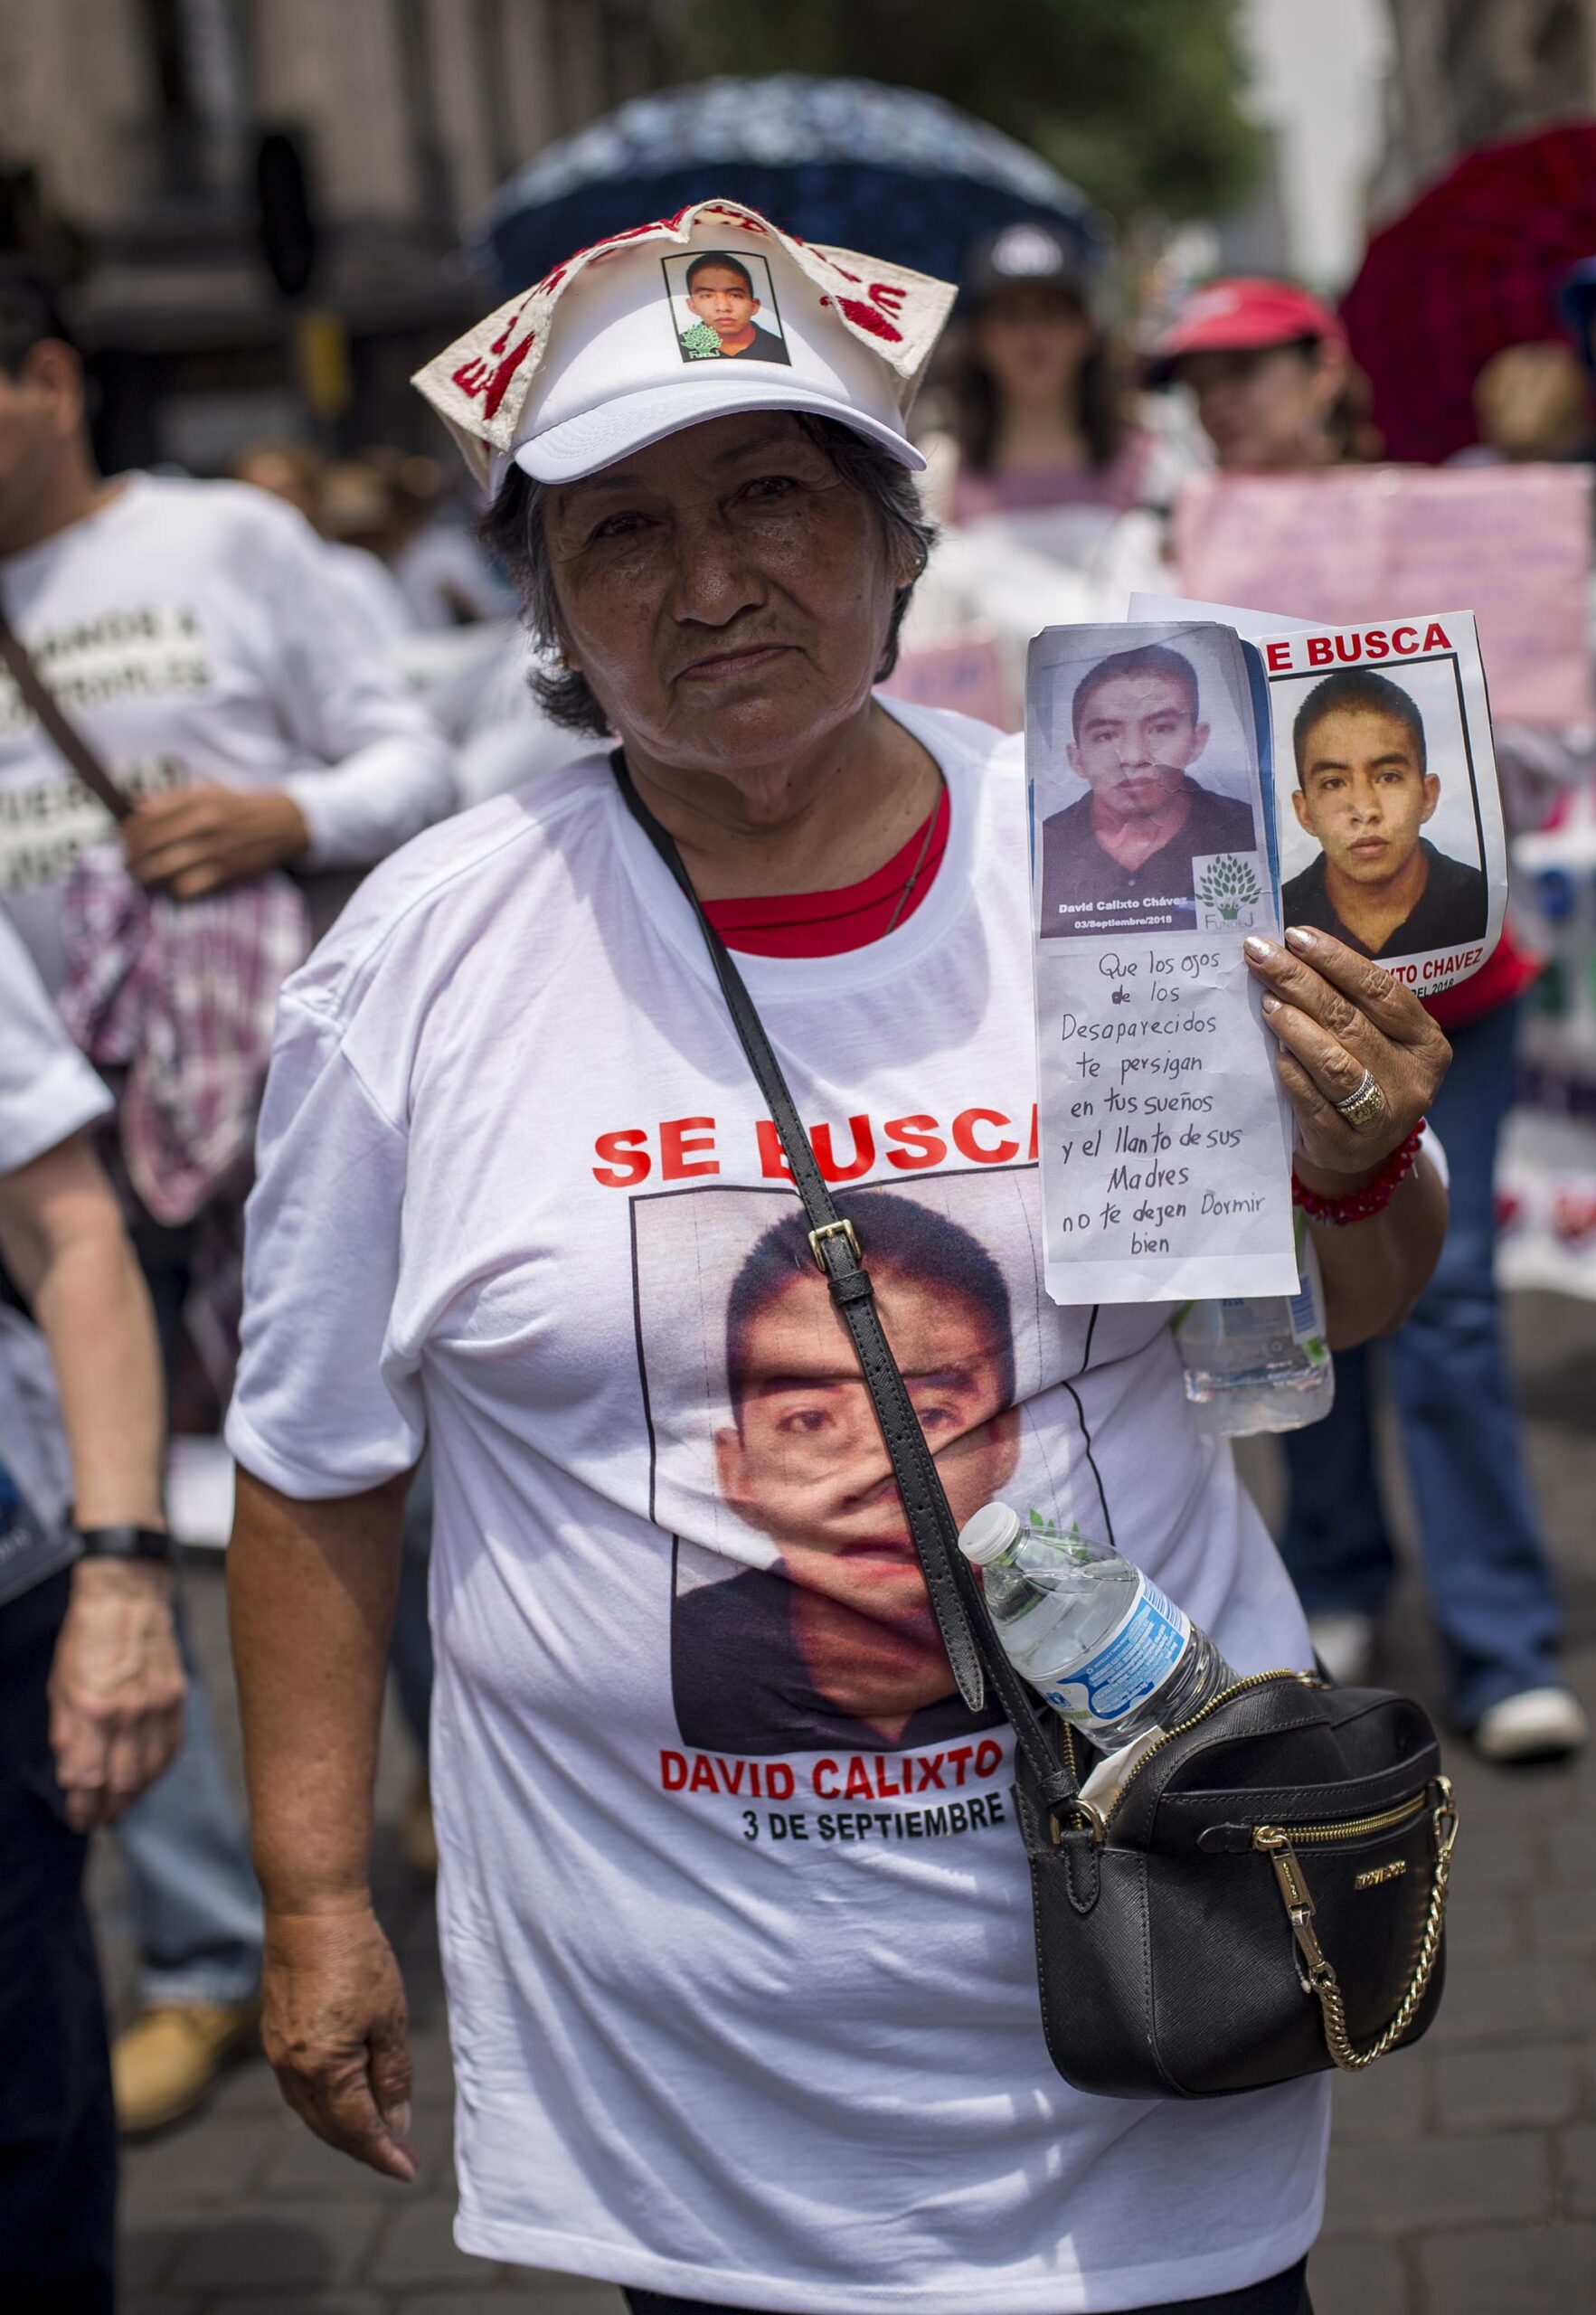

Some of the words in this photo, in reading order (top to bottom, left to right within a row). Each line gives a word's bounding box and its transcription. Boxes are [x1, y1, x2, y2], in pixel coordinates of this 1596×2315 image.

[1266, 641, 1293, 671] E
[1307, 622, 1453, 666] BUSCA
[1058, 902, 1093, 913] David
[1096, 900, 1139, 911] Calixto
[1074, 915, 1173, 929] 03/Septiembre/2018
[1099, 952, 1138, 979] Que
[1149, 950, 1175, 975] los
[1181, 952, 1221, 978] ojos
[1422, 947, 1484, 980] CHAVEZ
[1111, 984, 1131, 1005] de
[1150, 980, 1180, 1002] los
[1431, 978, 1455, 995] 2018
[1062, 1011, 1216, 1044] Desaparecidos
[1076, 1052, 1100, 1078] te
[1120, 1050, 1202, 1085] persigan
[1071, 1101, 1093, 1118] en
[1103, 1087, 1138, 1113] tus
[1144, 1092, 1214, 1115] sueños
[592, 1116, 721, 1188] SE
[754, 1102, 1039, 1186] BUSC
[1062, 1141, 1073, 1164] y
[1082, 1129, 1101, 1157] el
[1115, 1122, 1172, 1154] llanto
[1179, 1123, 1202, 1147] de
[1206, 1129, 1242, 1148] sus
[1107, 1158, 1189, 1193] Madres
[1062, 1214, 1091, 1232] no
[1100, 1203, 1121, 1230] te
[1132, 1200, 1186, 1227] dejen
[1201, 1192, 1265, 1215] Dormir
[1130, 1232, 1169, 1254] bien
[659, 1749, 795, 1800] DAVID
[812, 1739, 1003, 1800] CALIXTO
[742, 1809, 759, 1841] 3
[768, 1812, 809, 1840] DE
[818, 1791, 1005, 1841] SEPTIEMBRE
